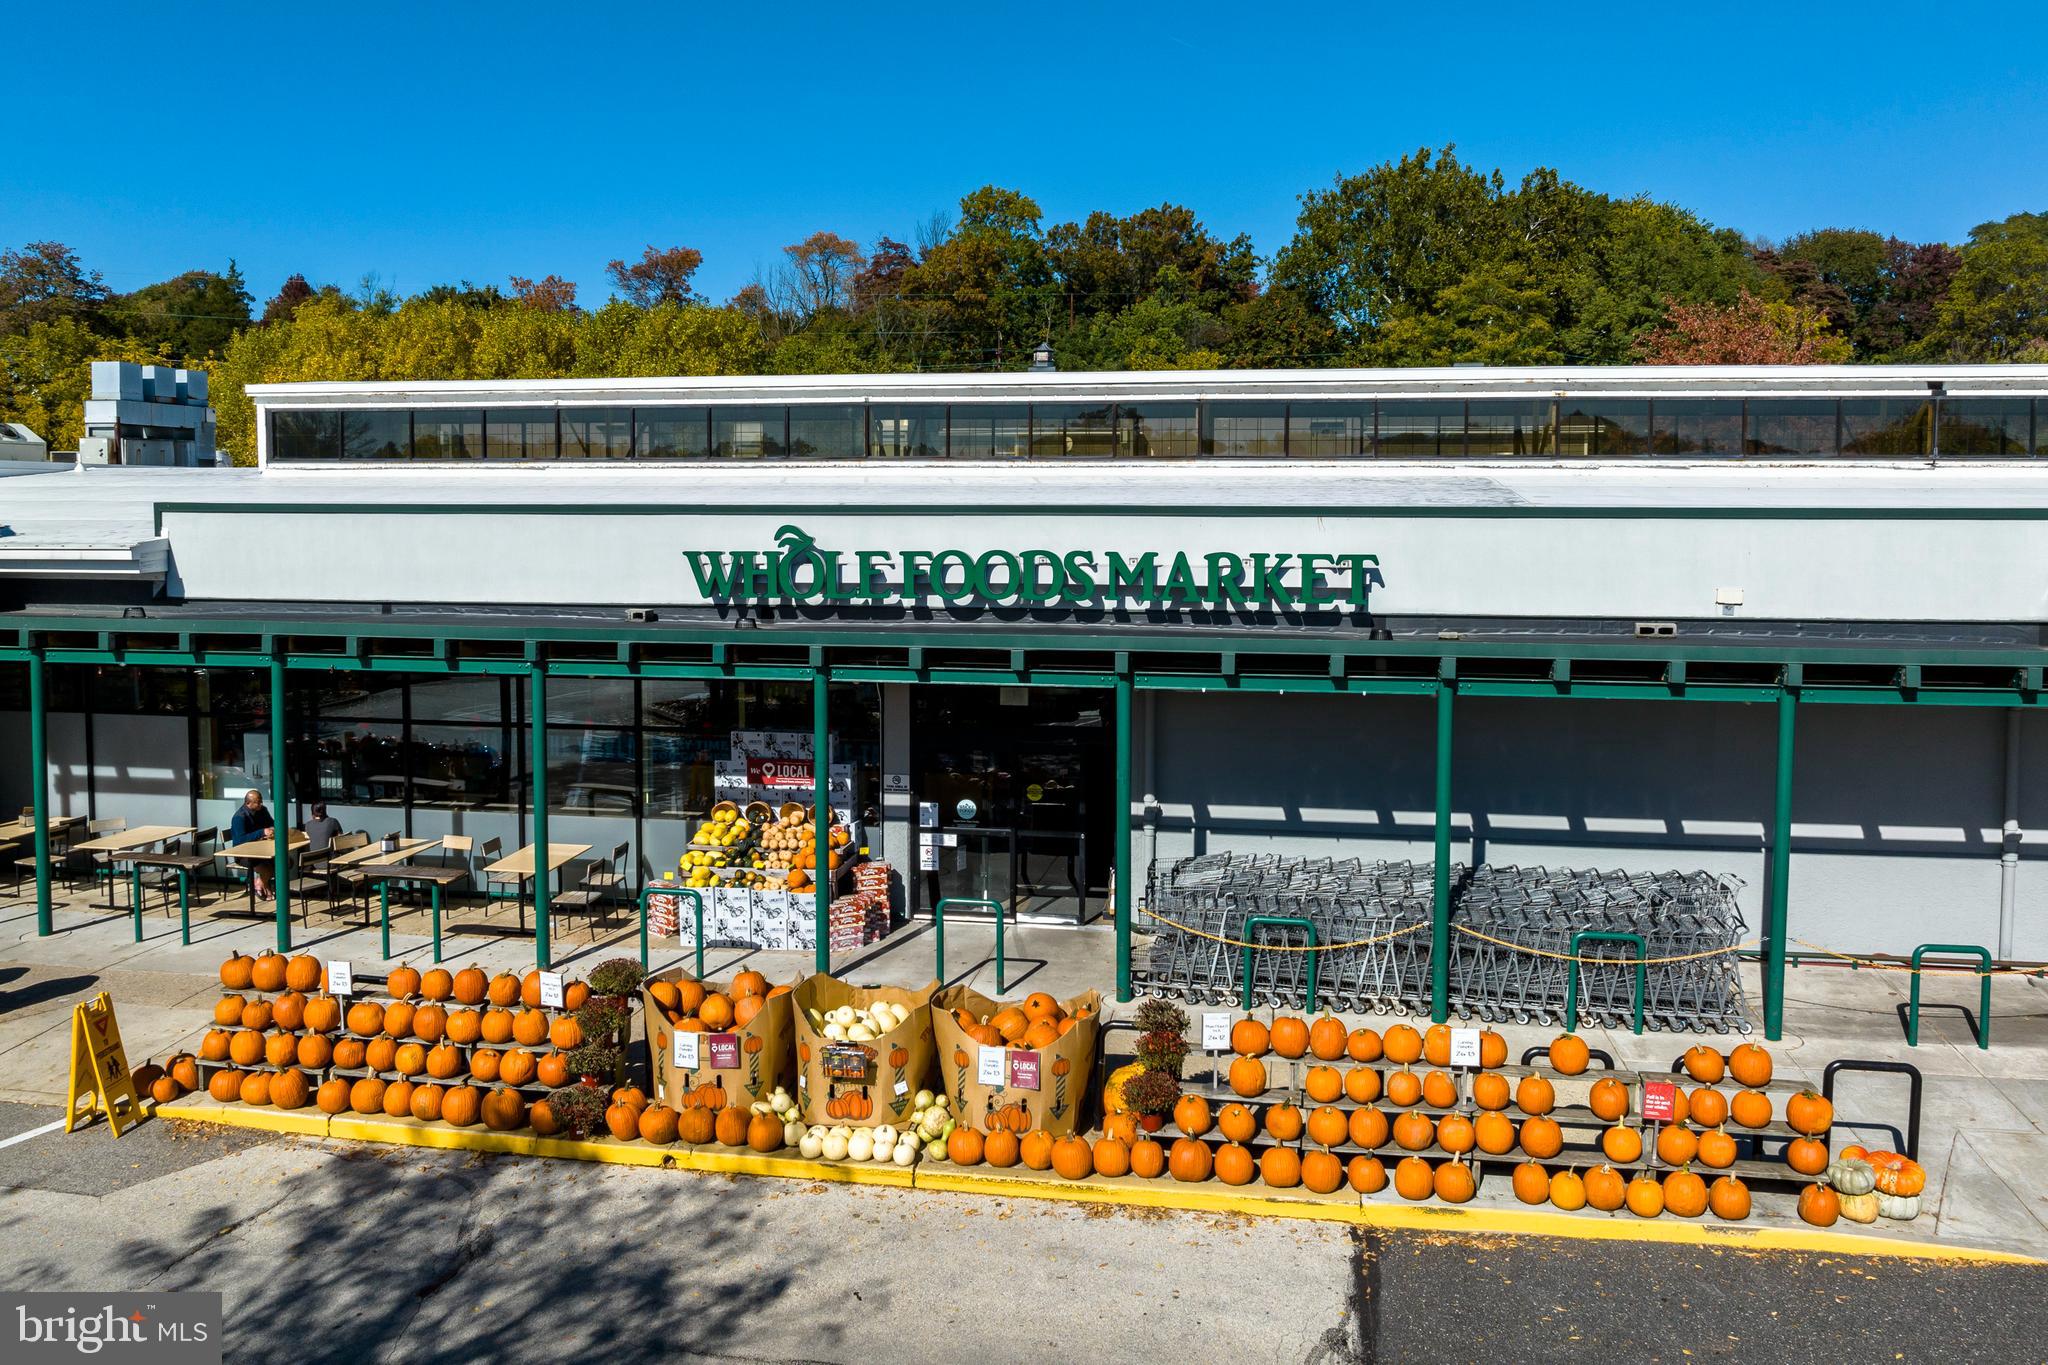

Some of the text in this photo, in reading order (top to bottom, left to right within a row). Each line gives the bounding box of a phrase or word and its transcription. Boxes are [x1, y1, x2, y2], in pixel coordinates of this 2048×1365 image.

[682, 525, 1380, 606] WHOLE FOODS MARKET
[750, 764, 810, 778] We LOCAL
[718, 1043, 735, 1051] LOCAL
[1019, 1062, 1037, 1071] LOCAL
